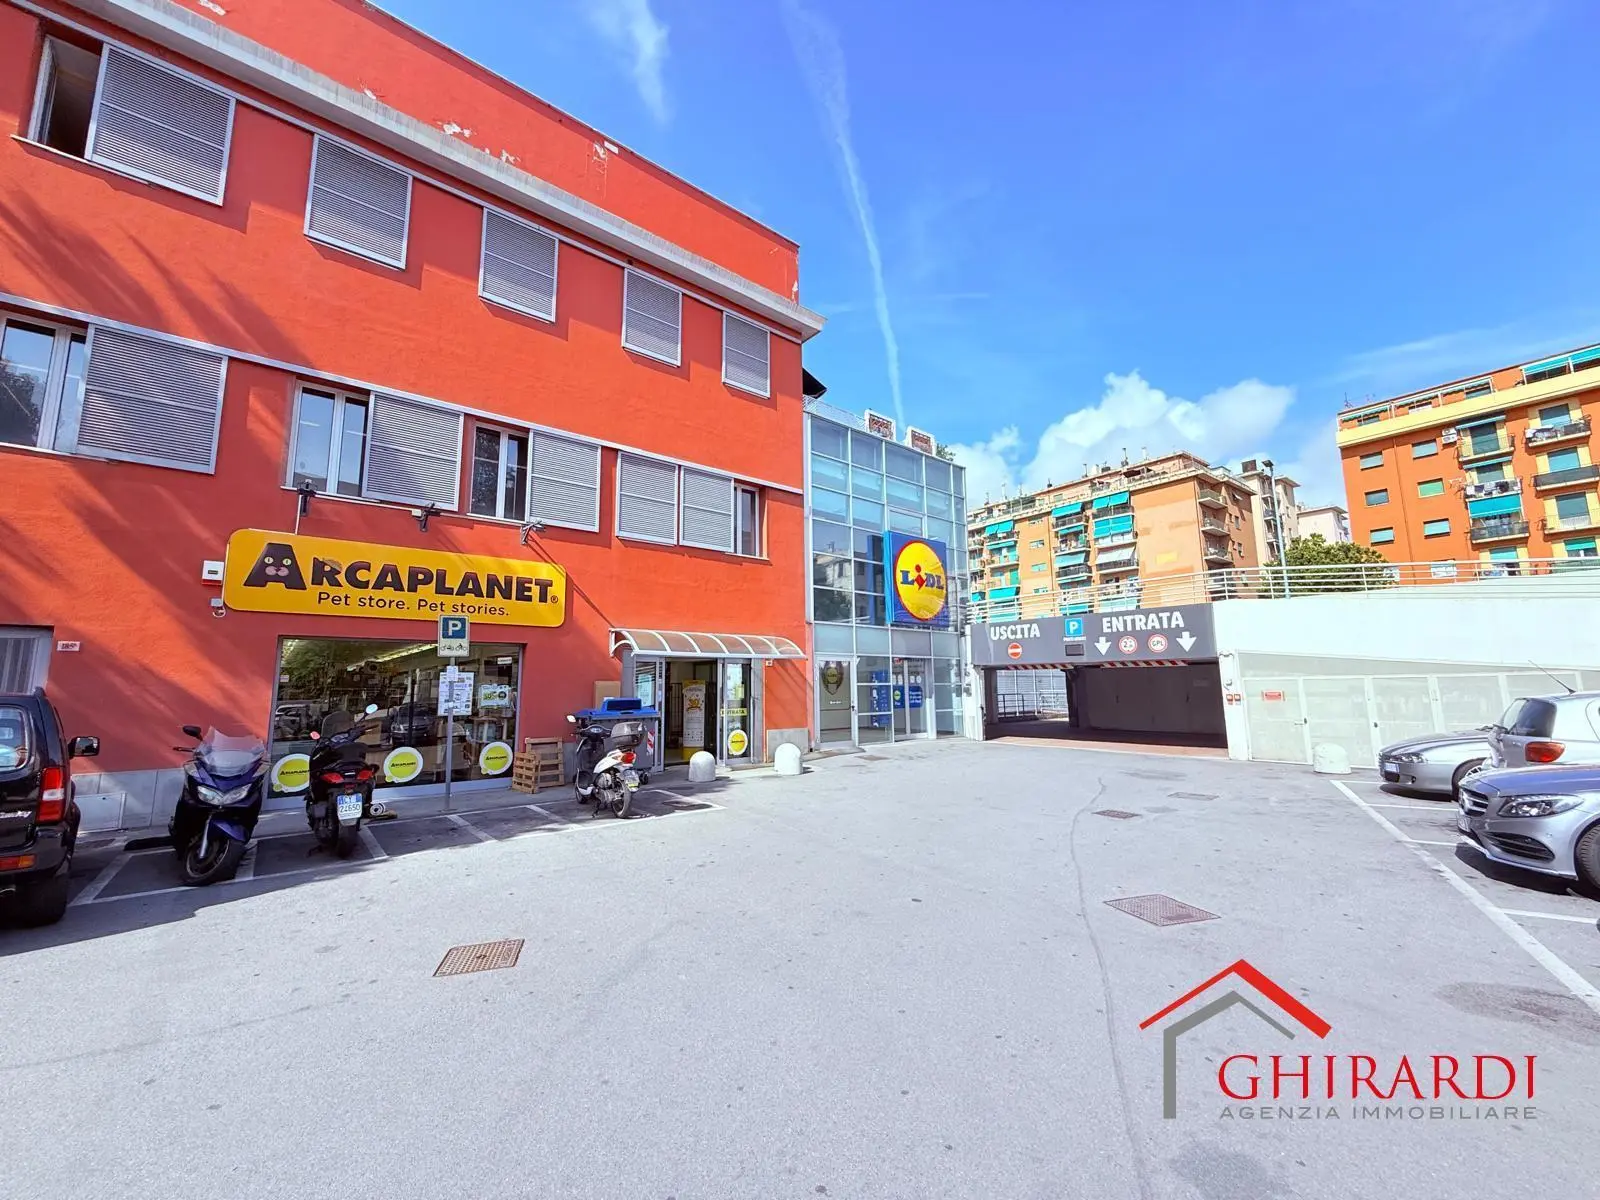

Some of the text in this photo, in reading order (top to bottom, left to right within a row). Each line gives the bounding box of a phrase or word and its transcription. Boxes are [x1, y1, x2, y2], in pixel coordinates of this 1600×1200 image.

[318, 591, 510, 616] Pet store. Pet stories.
[448, 620, 462, 636] P
[1069, 621, 1079, 634] P
[1102, 611, 1185, 633] ENTRATA
[990, 623, 1040, 641] USCITA
